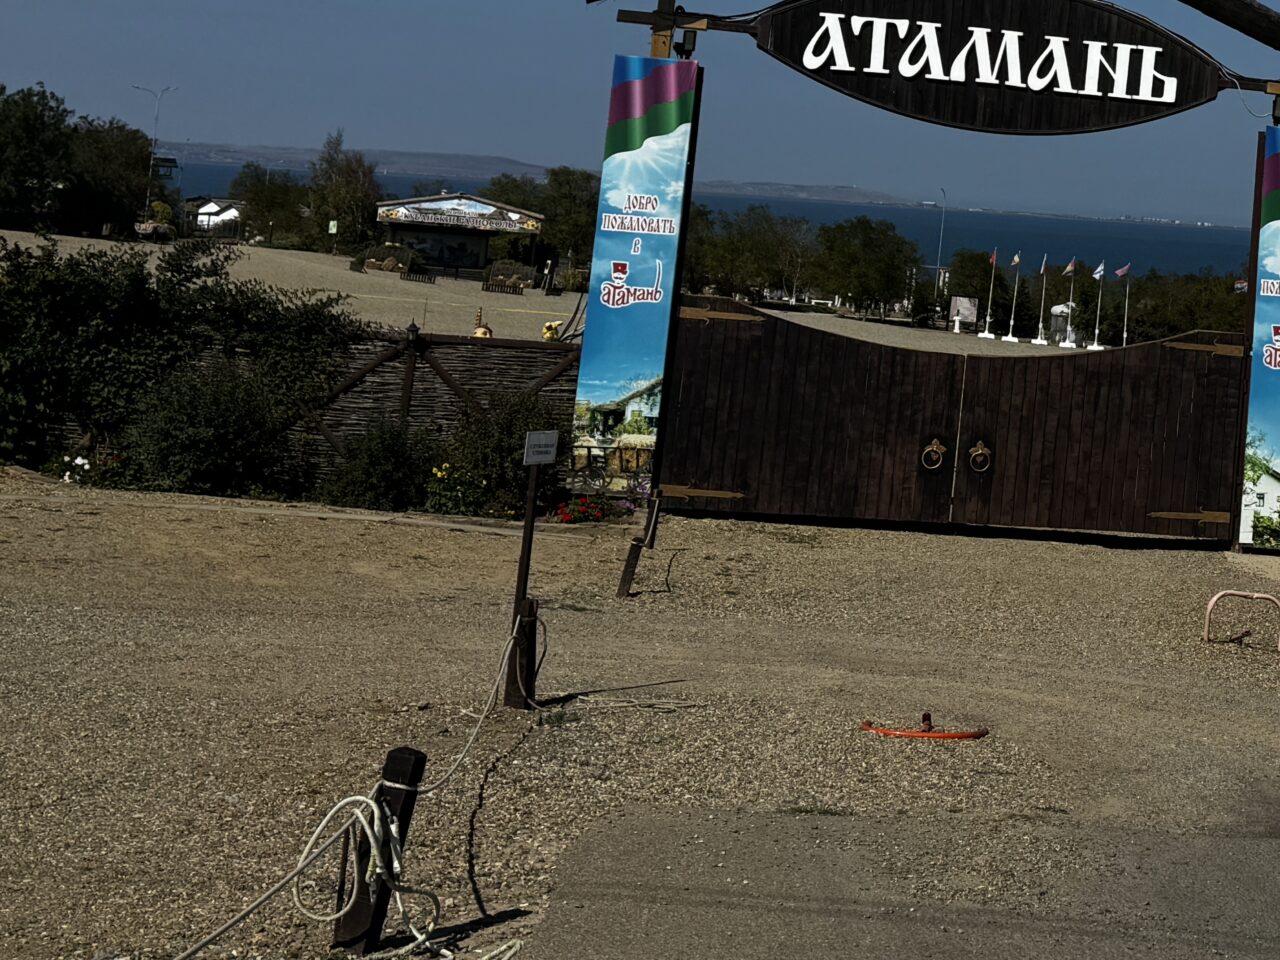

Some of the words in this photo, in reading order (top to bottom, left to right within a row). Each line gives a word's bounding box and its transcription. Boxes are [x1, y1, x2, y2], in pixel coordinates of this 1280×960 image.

[802, 12, 1177, 103] АТАМАНЬ
[624, 194, 658, 212] ДОБРО
[602, 214, 676, 234] ПОЖАЛОВАТЬ
